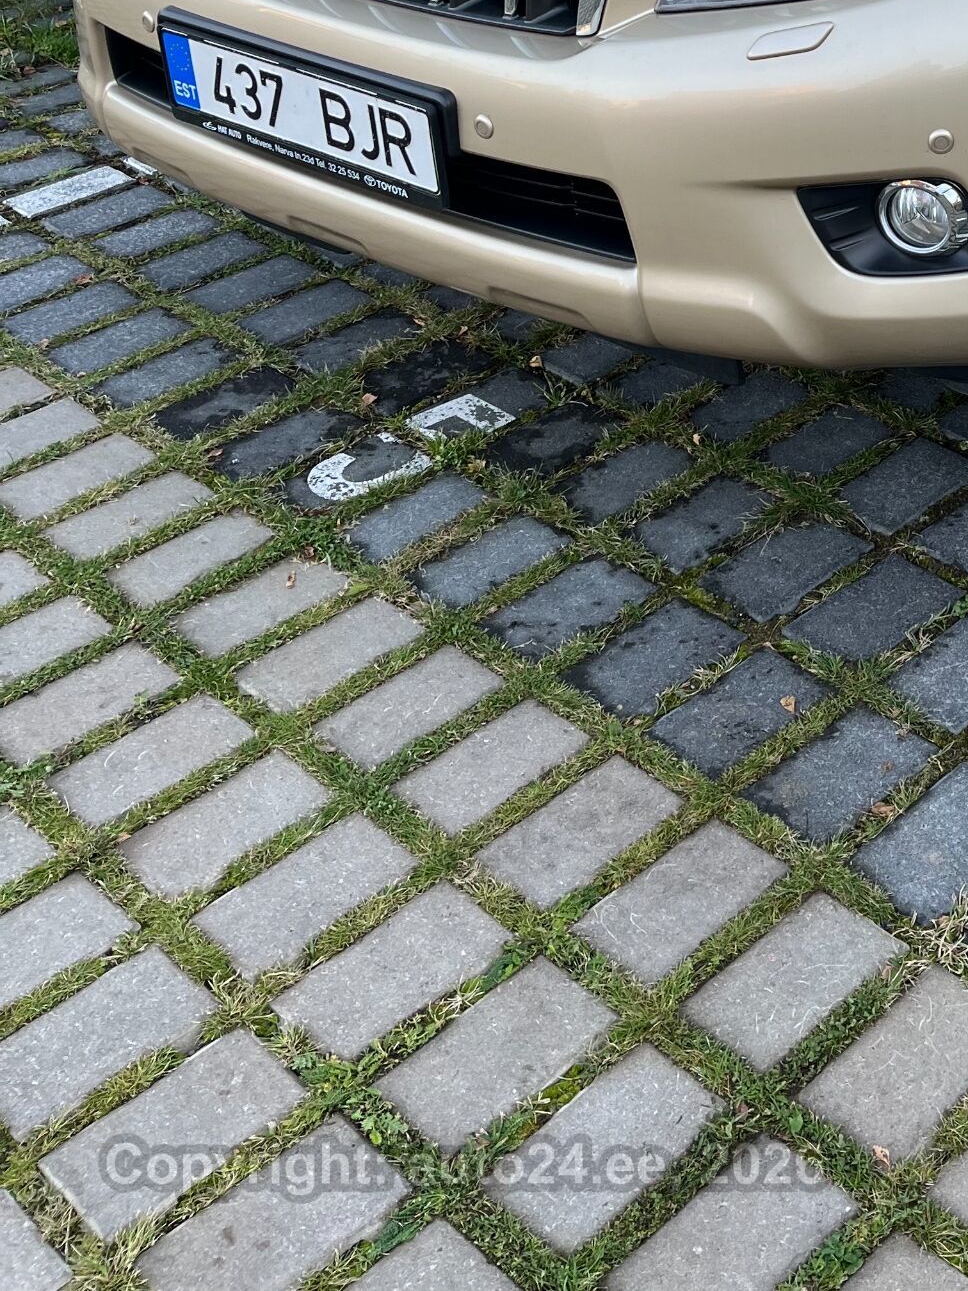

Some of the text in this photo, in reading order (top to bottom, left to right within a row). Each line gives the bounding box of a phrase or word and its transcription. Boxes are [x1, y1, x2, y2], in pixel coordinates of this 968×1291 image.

[174, 80, 197, 101] EST
[213, 56, 417, 177] 437 BJR
[228, 128, 242, 140] AUTO
[246, 133, 275, 152] Rakvere,
[274, 143, 294, 159] Narva
[327, 162, 337, 173] 32
[338, 166, 347, 177] 25
[347, 169, 360, 181] 534
[375, 179, 408, 199] TOYOTA
